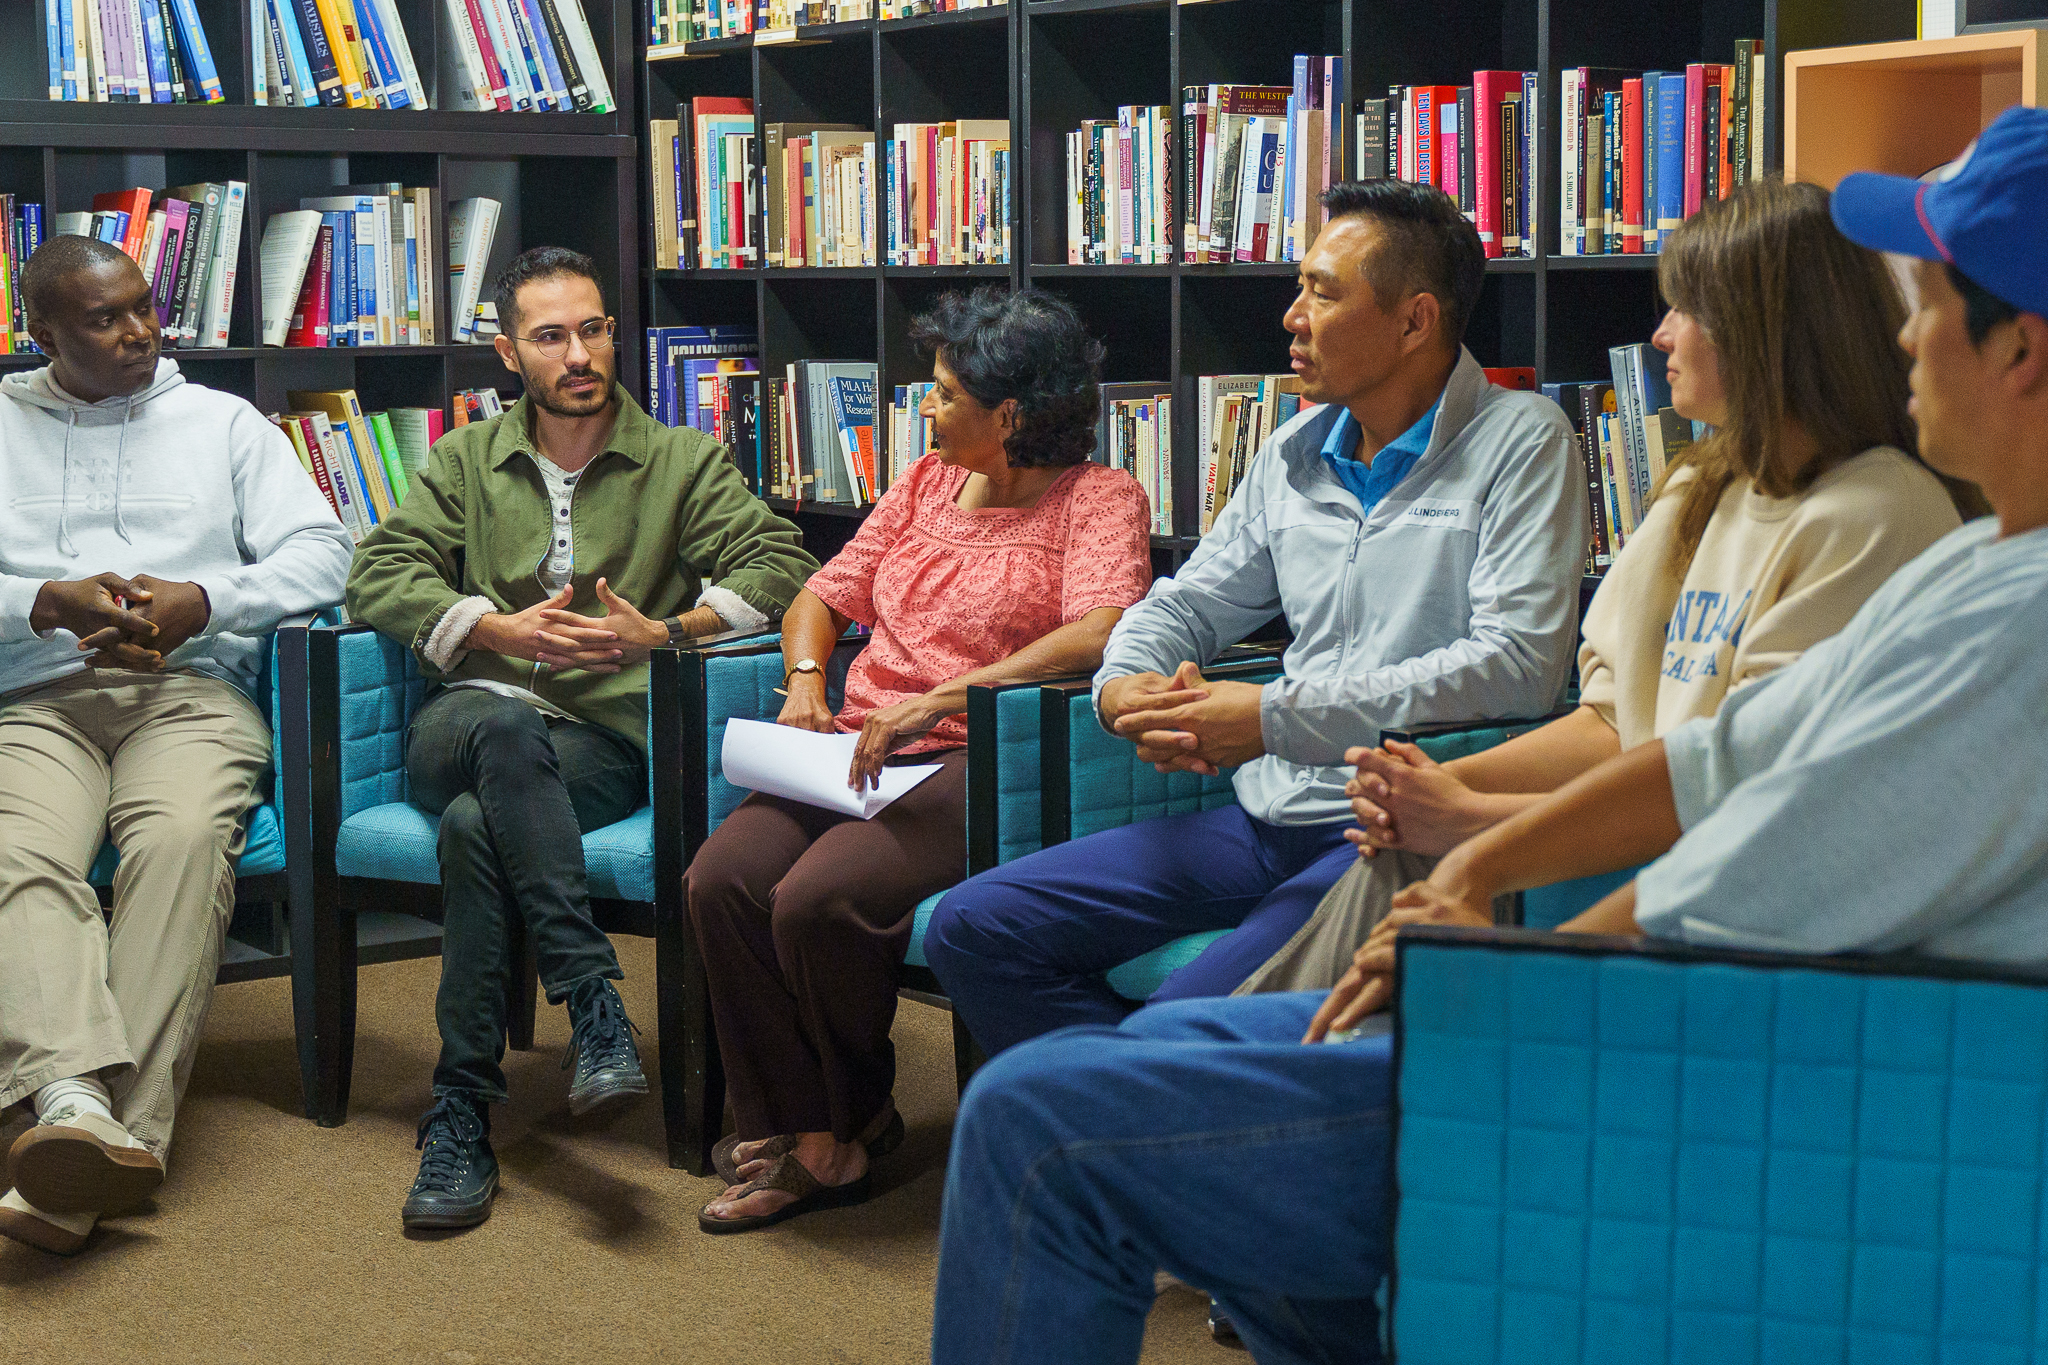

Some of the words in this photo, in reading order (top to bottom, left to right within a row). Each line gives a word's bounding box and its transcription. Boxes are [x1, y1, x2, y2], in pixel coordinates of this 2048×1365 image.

[191, 27, 205, 55] BUSINESS
[307, 0, 329, 57] TATISTICS
[545, 0, 559, 34] Marketing
[557, 35, 577, 80] Management
[1239, 91, 1258, 100] THE
[1418, 93, 1430, 109] TEN
[1418, 113, 1430, 136] DAYS
[1477, 110, 1482, 119] IN
[1506, 109, 1511, 117] IN
[1624, 100, 1633, 141] American
[1188, 150, 1194, 158] OF
[1276, 143, 1285, 167] 1913
[1419, 139, 1430, 149] TO
[1567, 144, 1574, 152] IN
[1419, 153, 1430, 184] DESTIN
[1477, 175, 1483, 184] by
[187, 215, 198, 240] Global
[200, 207, 216, 260] International
[227, 210, 241, 269] International
[306, 226, 317, 247] Zook
[477, 217, 490, 259] MARKETING
[181, 241, 193, 276] Business
[175, 278, 187, 301] Today
[193, 262, 205, 299] Business
[223, 271, 234, 313] Business
[288, 268, 304, 313] unstoppable
[469, 262, 482, 303] RESEARCH
[650, 336, 658, 390] HOLLYWOOD
[840, 380, 861, 392] MLA
[843, 392, 854, 402] for
[832, 394, 842, 423] Handbook
[1622, 405, 1631, 451] HAROLD
[1633, 398, 1645, 463] AMERICAN
[379, 417, 394, 451] Mavericks
[392, 459, 402, 477] Work
[334, 472, 350, 506] LEADER
[1207, 463, 1216, 492] IVAN'S
[1204, 492, 1213, 512] WAR
